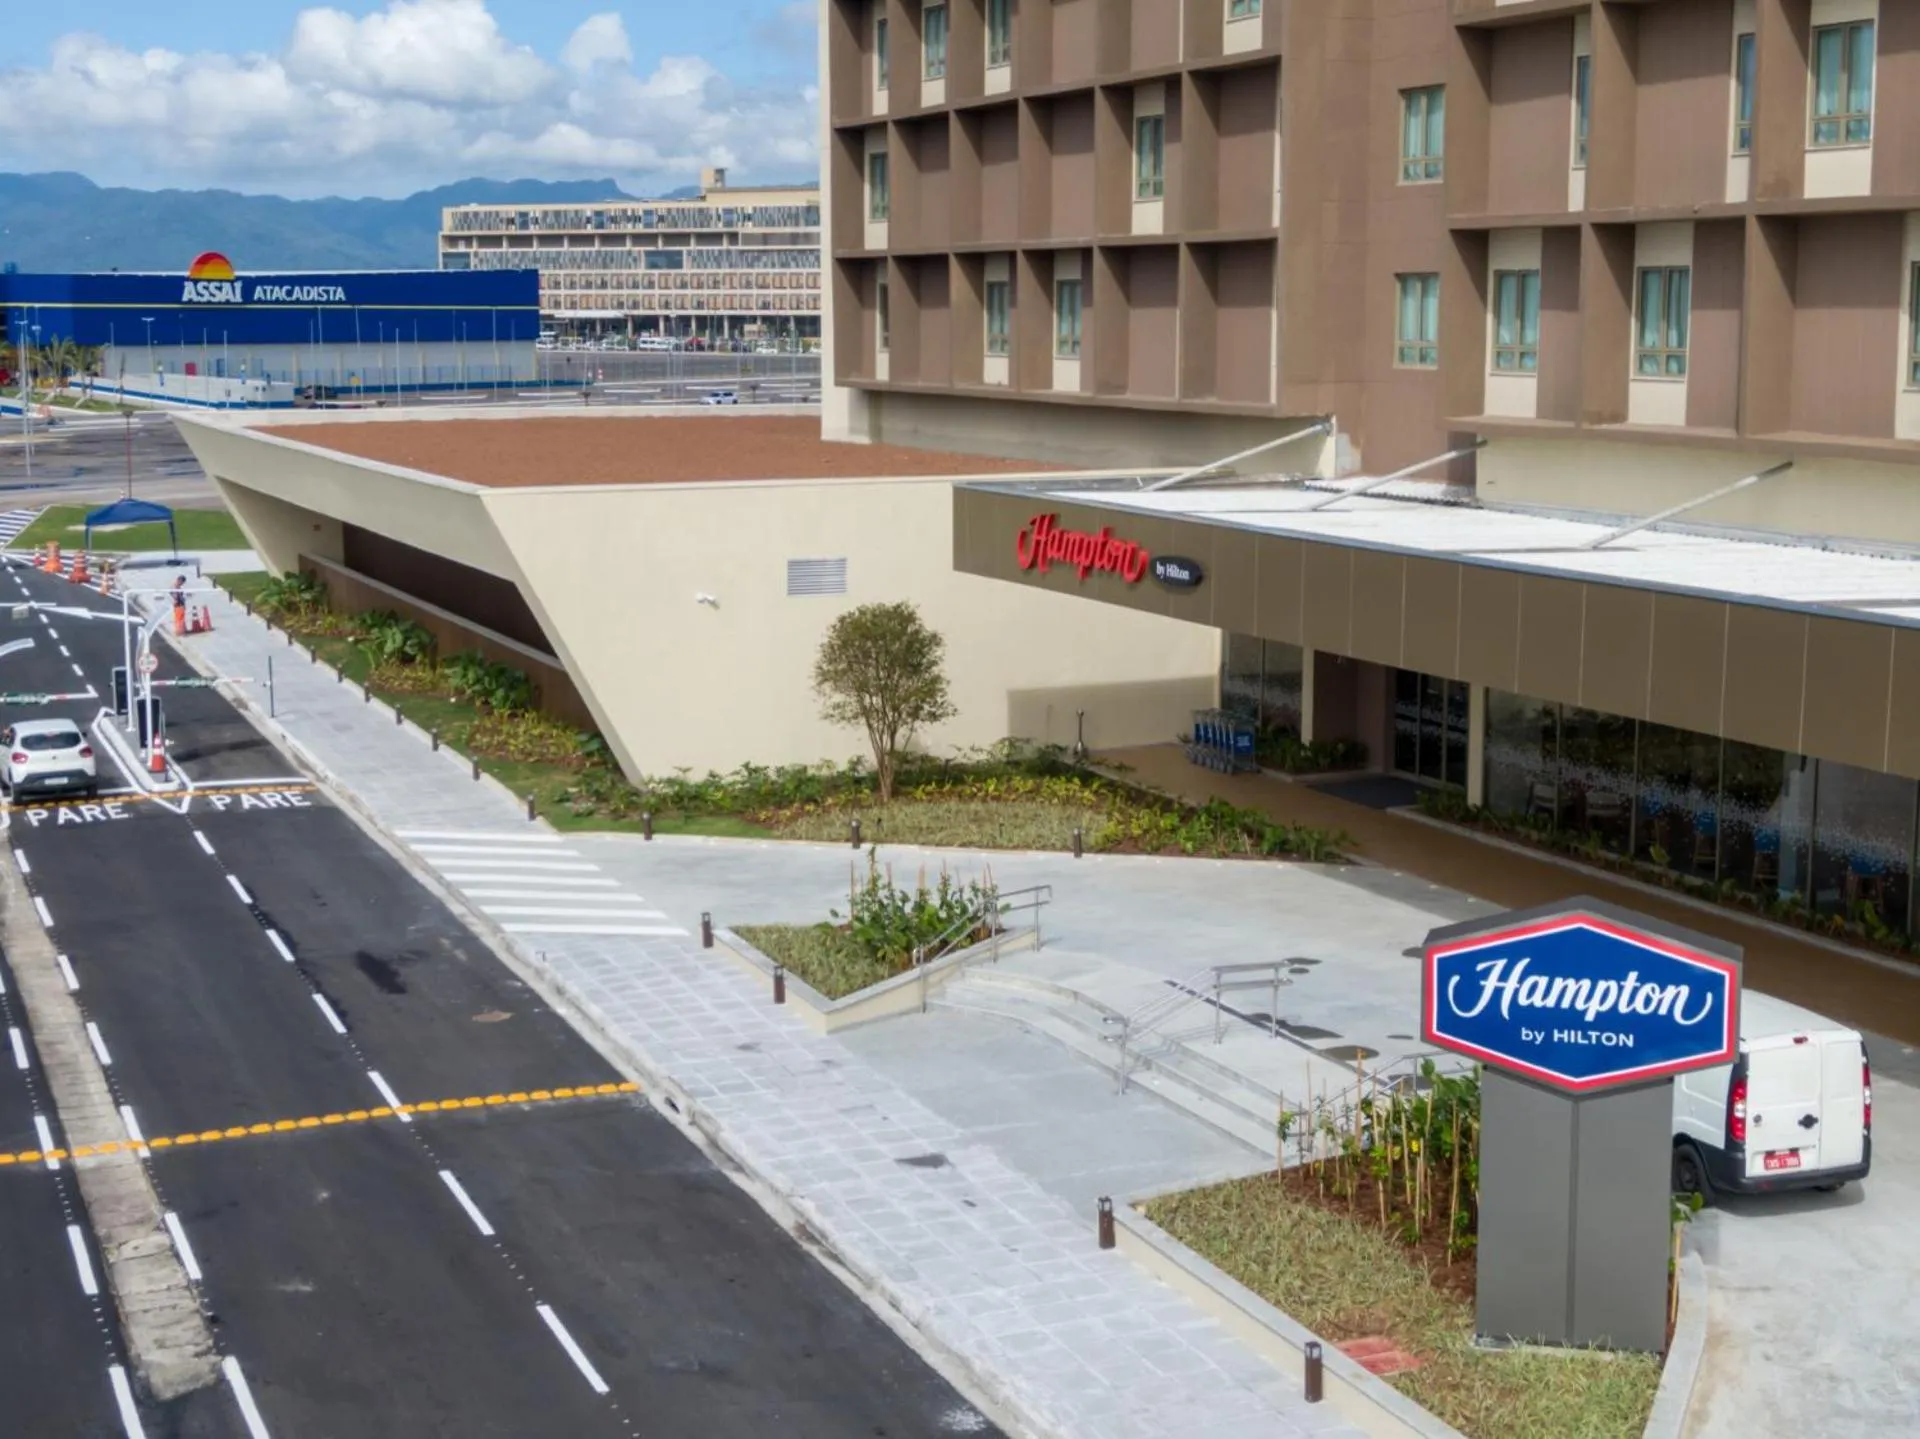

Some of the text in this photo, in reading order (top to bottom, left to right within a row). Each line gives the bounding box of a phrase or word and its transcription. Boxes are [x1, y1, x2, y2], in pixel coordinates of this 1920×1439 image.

[254, 285, 346, 301] ATACADISTA
[1017, 513, 1150, 584] Hampton
[1156, 560, 1190, 580] by Hilton
[208, 790, 312, 811] PARE
[25, 802, 129, 827] PARE
[1448, 957, 1712, 1025] Hampton
[1521, 1027, 1634, 1047] by HILTON
